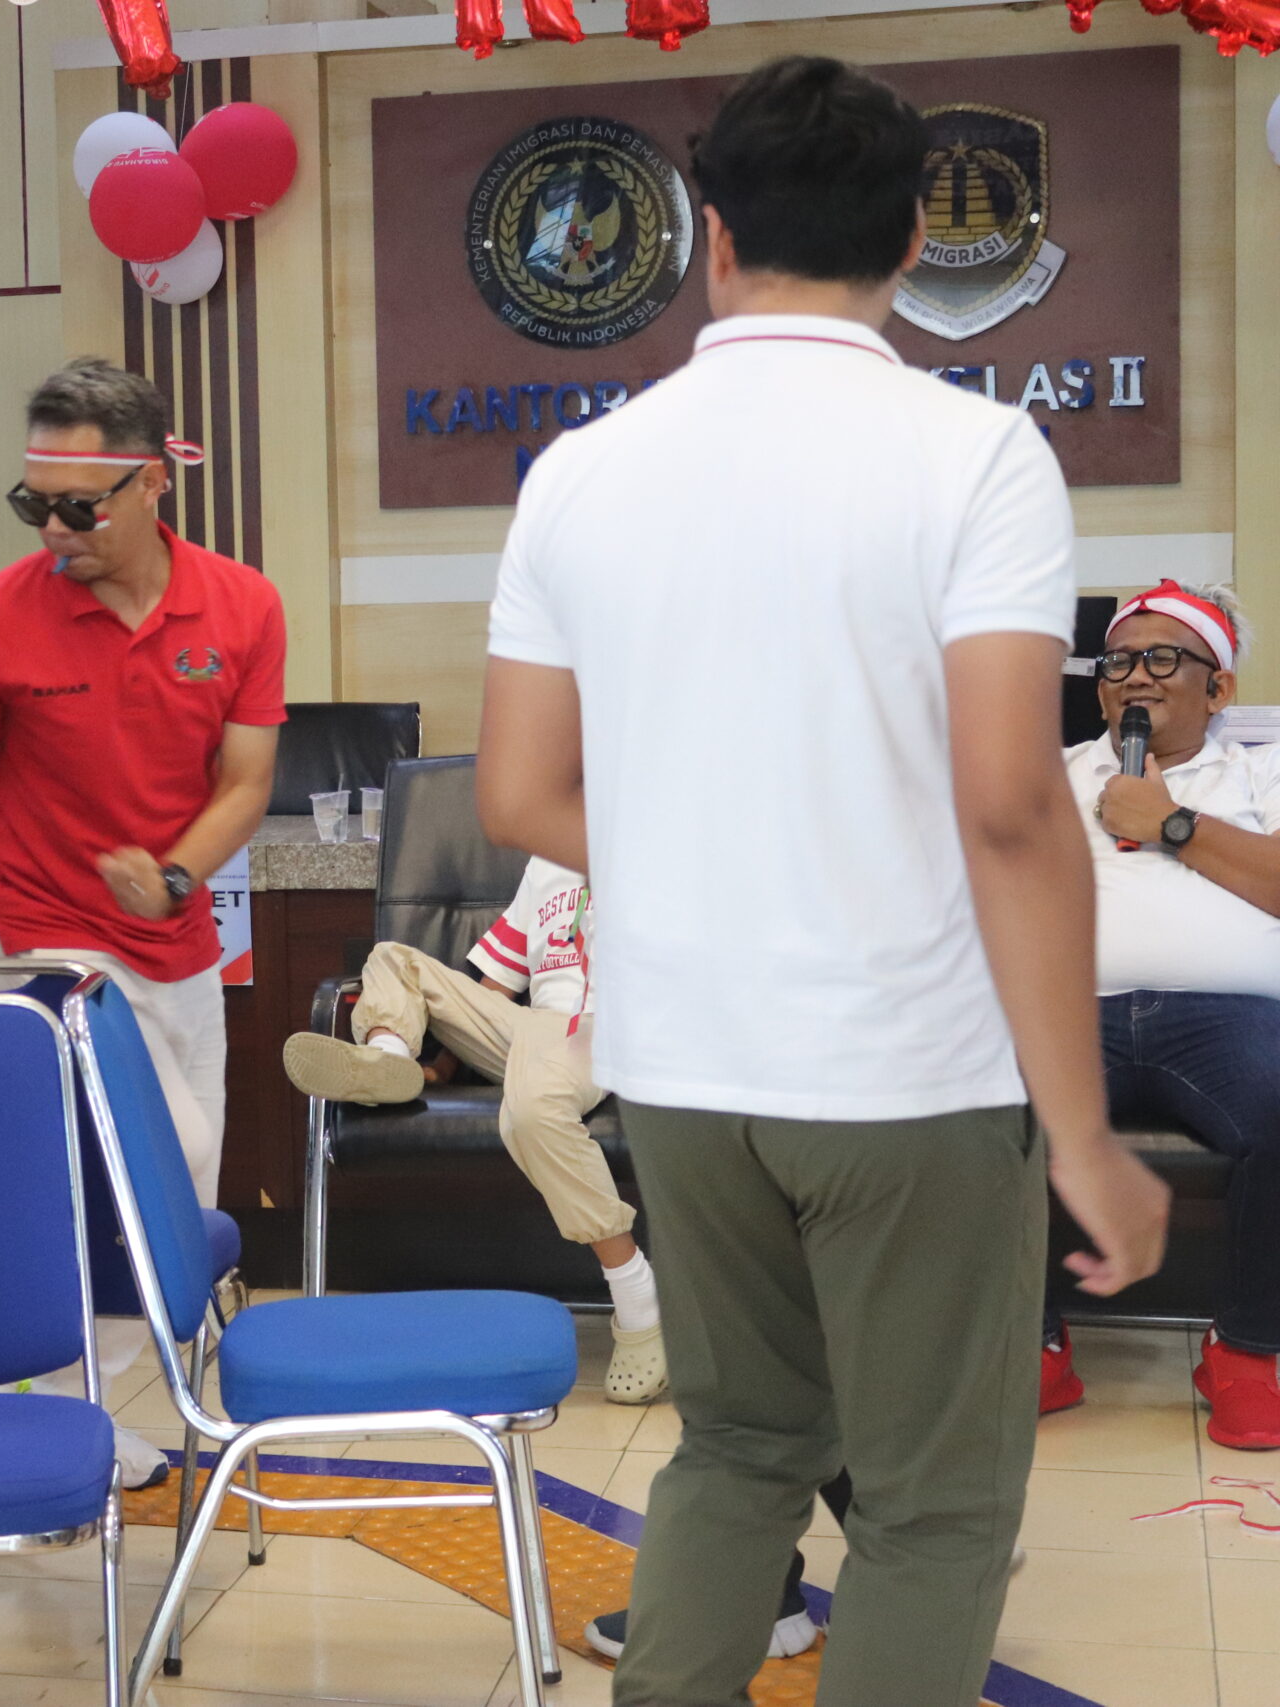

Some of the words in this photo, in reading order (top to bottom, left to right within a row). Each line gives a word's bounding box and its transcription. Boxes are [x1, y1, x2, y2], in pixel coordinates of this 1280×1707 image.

[470, 166, 507, 283] KEMENTERIAN
[505, 124, 576, 165] IMIGRASI
[580, 122, 617, 140] DAN
[921, 237, 1002, 264] MIGRASI
[501, 302, 571, 342] REPUBLIK
[576, 298, 658, 343] INDONESIA
[405, 381, 628, 434] KANTOR
[538, 891, 567, 929] BEST
